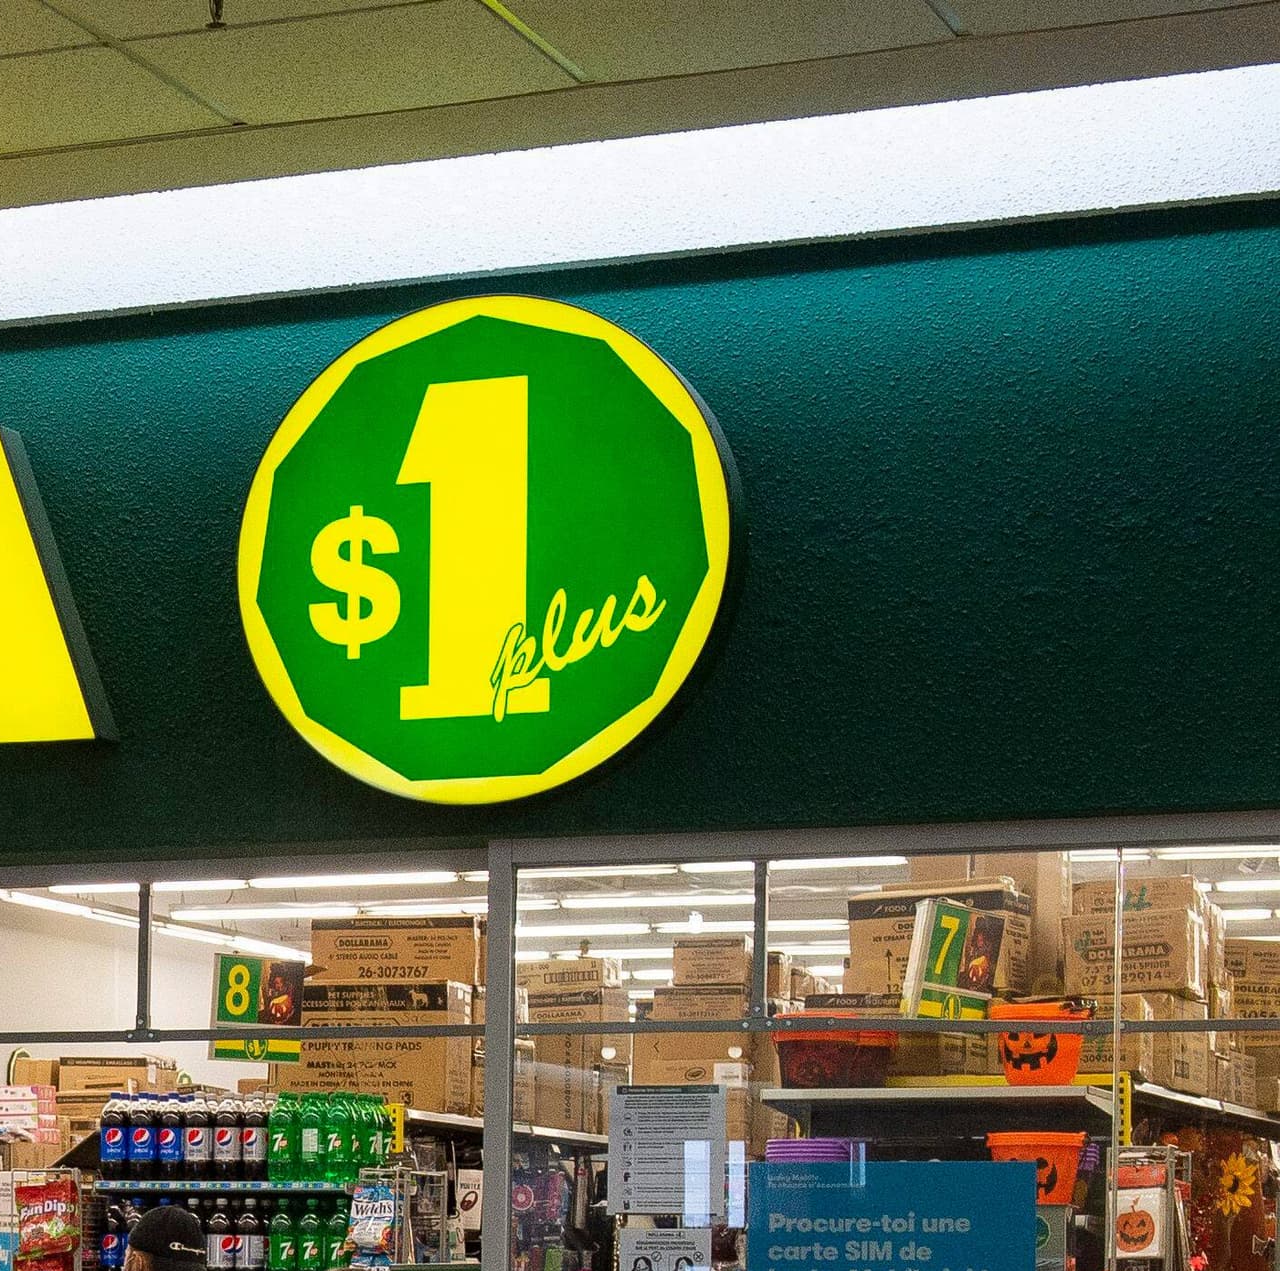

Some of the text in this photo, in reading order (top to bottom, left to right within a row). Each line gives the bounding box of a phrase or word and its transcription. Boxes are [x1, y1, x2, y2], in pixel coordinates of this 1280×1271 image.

[489, 574, 667, 723] plus
[339, 938, 389, 948] DOLLARAMA
[934, 915, 961, 975] 7
[1088, 944, 1168, 961] DOLARAMA
[358, 966, 429, 979] 26-3073767
[225, 964, 250, 1016] 8
[395, 1041, 422, 1051] PADS
[20, 1200, 67, 1220] Fun Dip
[768, 1211, 971, 1234] Procure-toi une
[768, 1240, 933, 1261] carte SIM de
